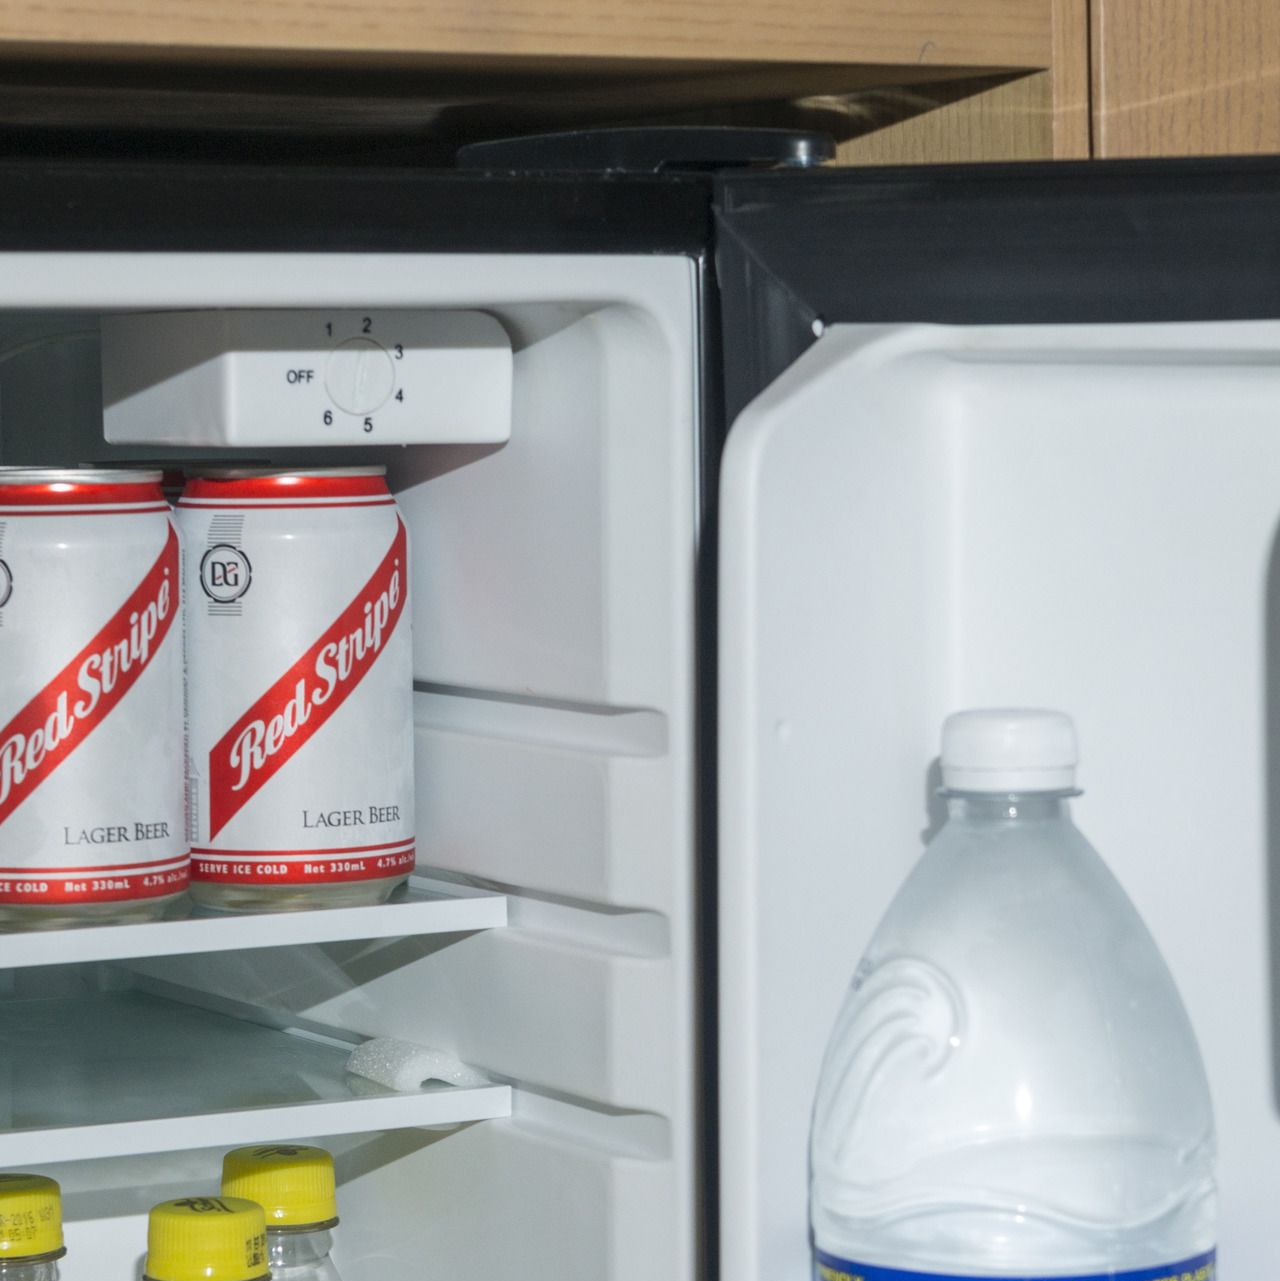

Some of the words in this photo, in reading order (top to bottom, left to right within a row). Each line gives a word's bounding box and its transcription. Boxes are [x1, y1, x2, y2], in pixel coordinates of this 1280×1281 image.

[325, 322, 333, 336] 1
[361, 317, 372, 333] 2
[394, 345, 404, 360] 3
[285, 370, 315, 384] OFF
[394, 389, 404, 403] 4
[323, 410, 333, 426] 6
[363, 417, 373, 433] 5
[73, 567, 171, 719] Stripe
[230, 678, 312, 792] Red
[311, 558, 400, 706] Stripe
[302, 809, 365, 829] LAGER
[369, 804, 401, 824] BEER
[63, 826, 131, 846] LAGER
[133, 821, 171, 841] BEER
[199, 862, 229, 875] SERVE
[233, 863, 251, 875] ICE
[256, 863, 288, 875] COLD
[304, 862, 326, 874] Net
[330, 860, 366, 872] 330mL
[16, 881, 49, 893] COLD
[64, 880, 88, 892] Net
